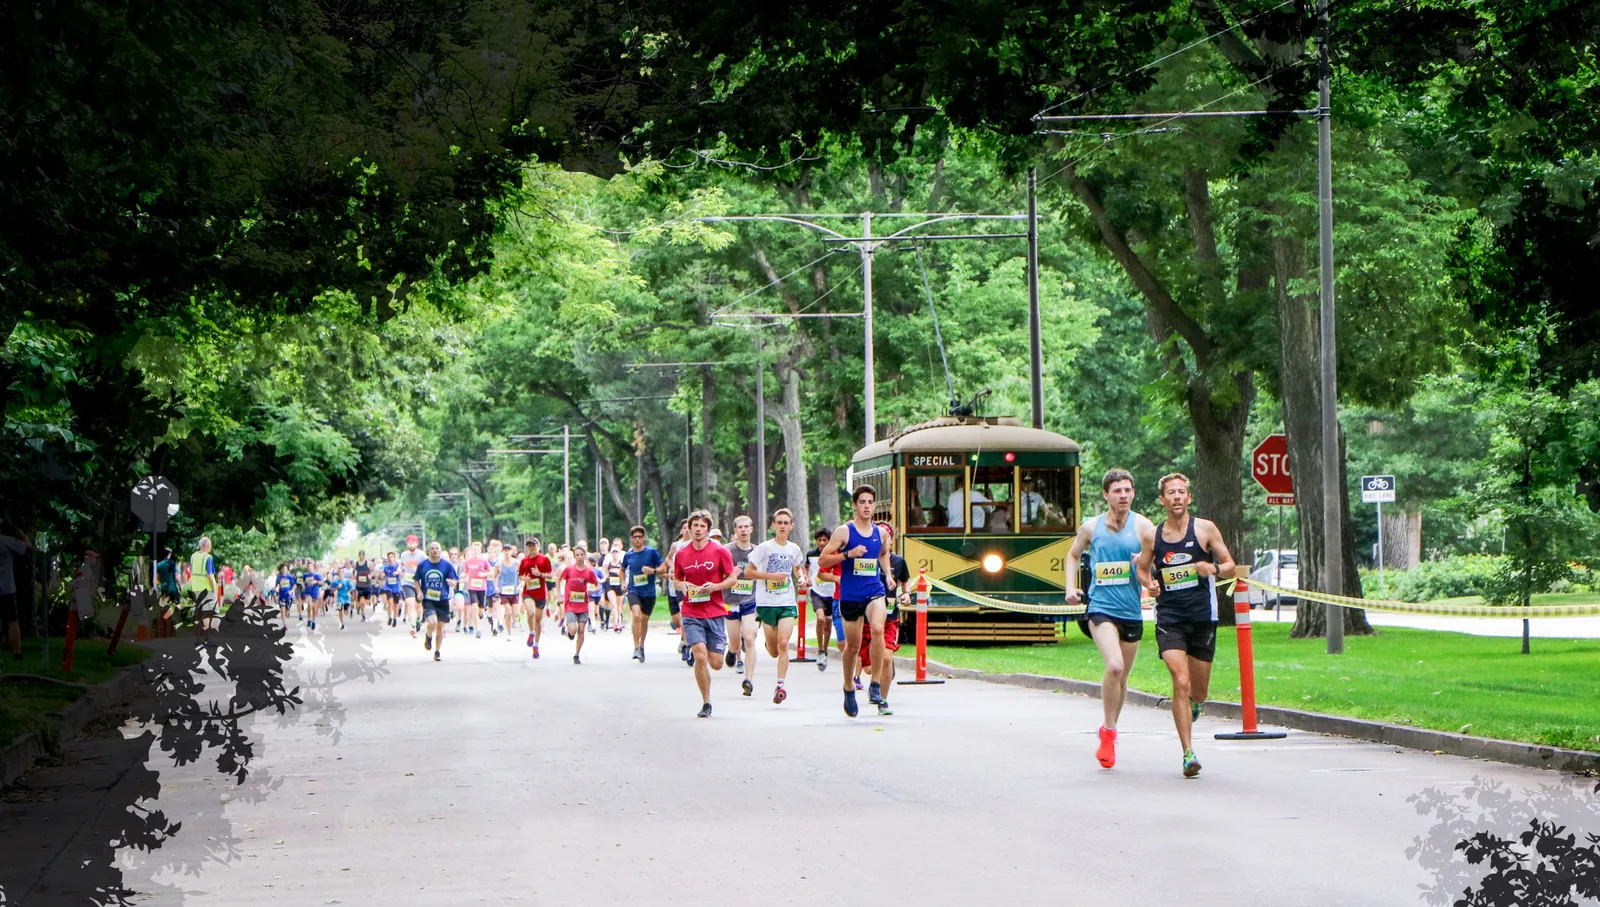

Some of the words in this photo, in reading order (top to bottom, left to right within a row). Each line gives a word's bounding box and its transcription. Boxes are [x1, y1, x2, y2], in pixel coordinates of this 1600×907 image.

[913, 456, 955, 466] SPECIAL
[1256, 453, 1290, 476] STO
[918, 558, 934, 572] 21
[1050, 557, 1065, 572] 21
[1102, 567, 1123, 576] 440
[1169, 570, 1190, 581] 364
